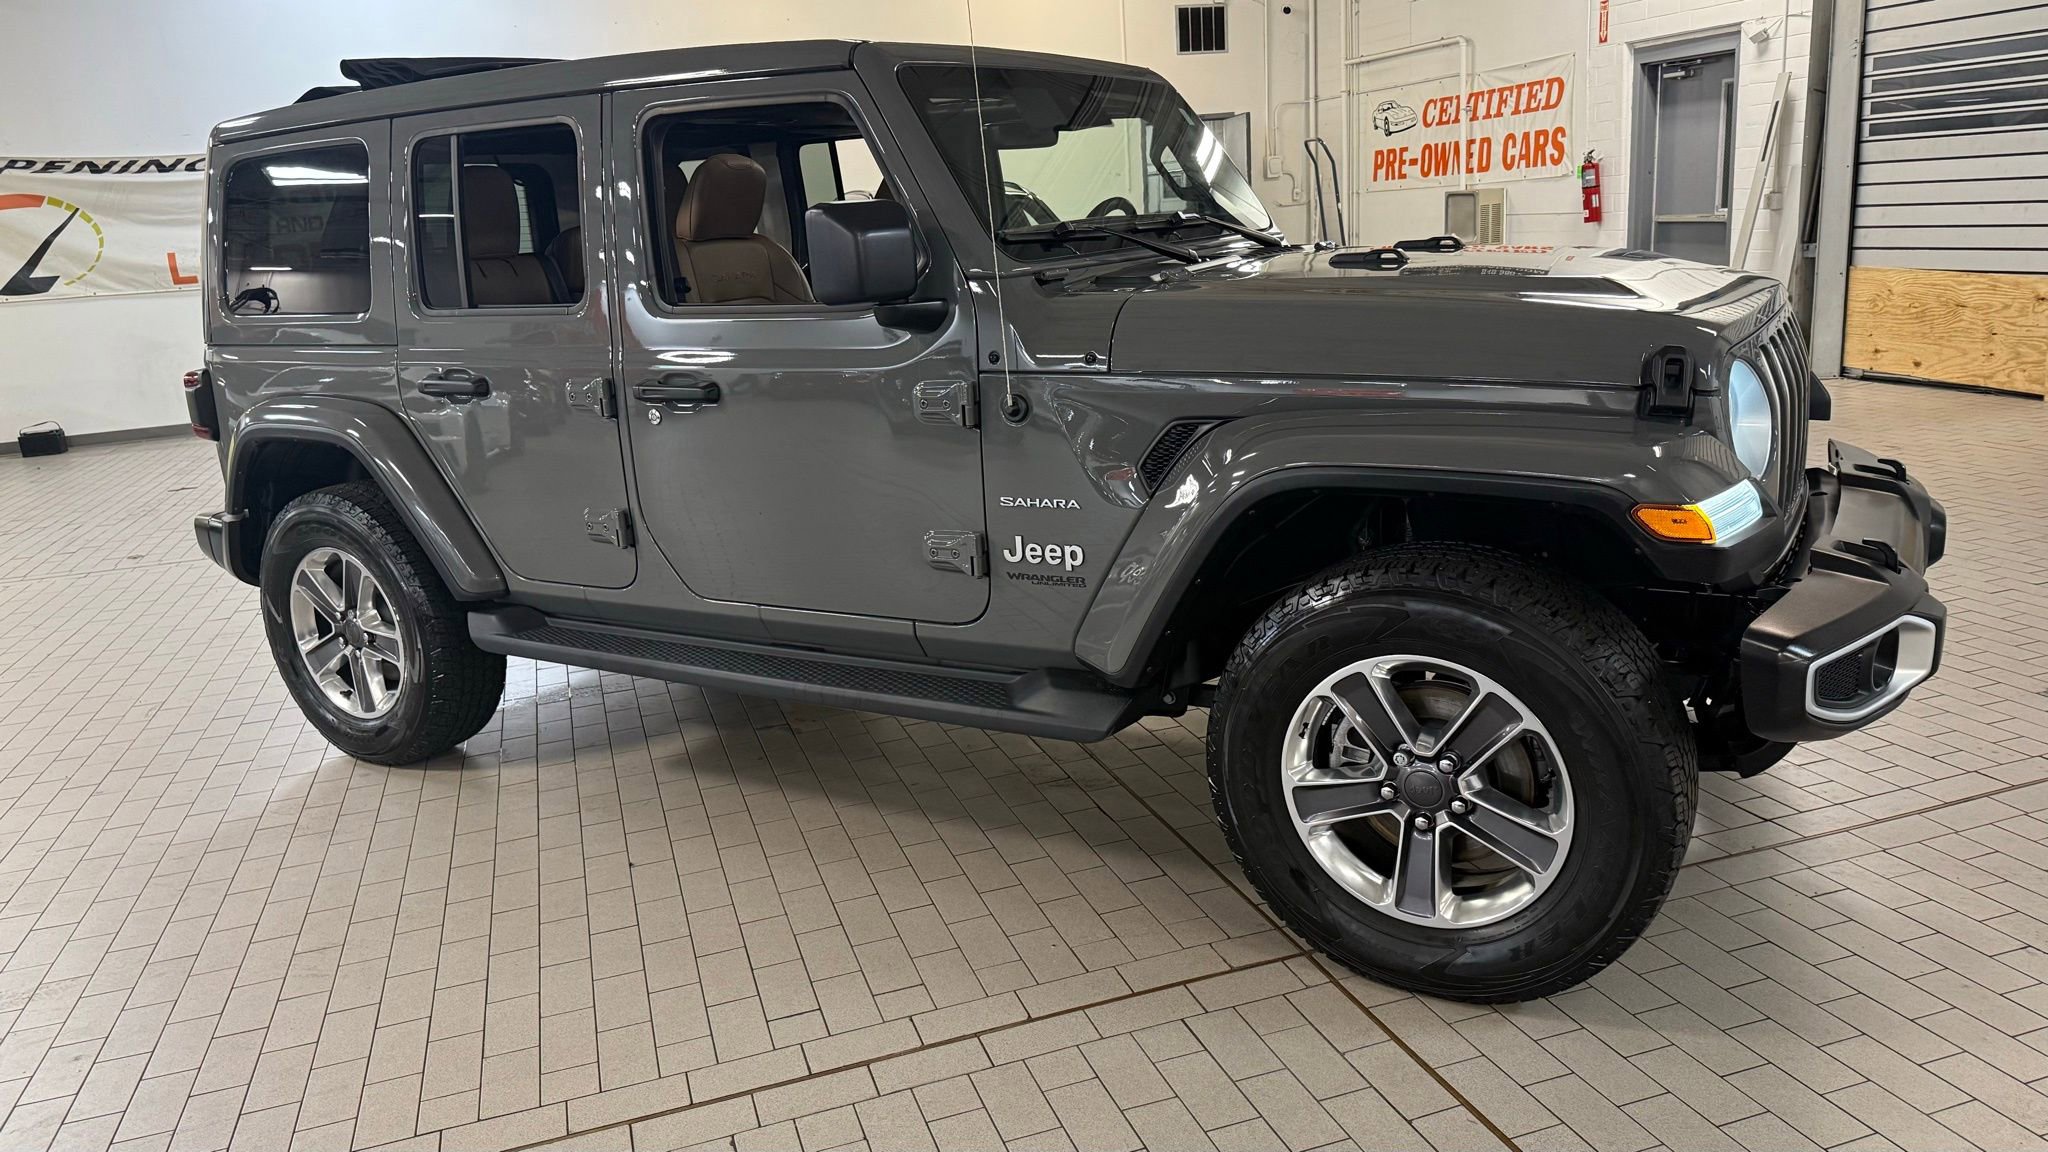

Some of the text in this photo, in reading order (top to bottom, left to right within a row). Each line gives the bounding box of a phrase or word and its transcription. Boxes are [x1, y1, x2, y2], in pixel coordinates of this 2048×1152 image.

[1502, 126, 1567, 171] CARS
[1000, 496, 1081, 510] SAHARA
[1003, 535, 1085, 572] Jeep
[1006, 571, 1086, 584] WRANGLER
[1031, 580, 1087, 588] UNLIMITED
